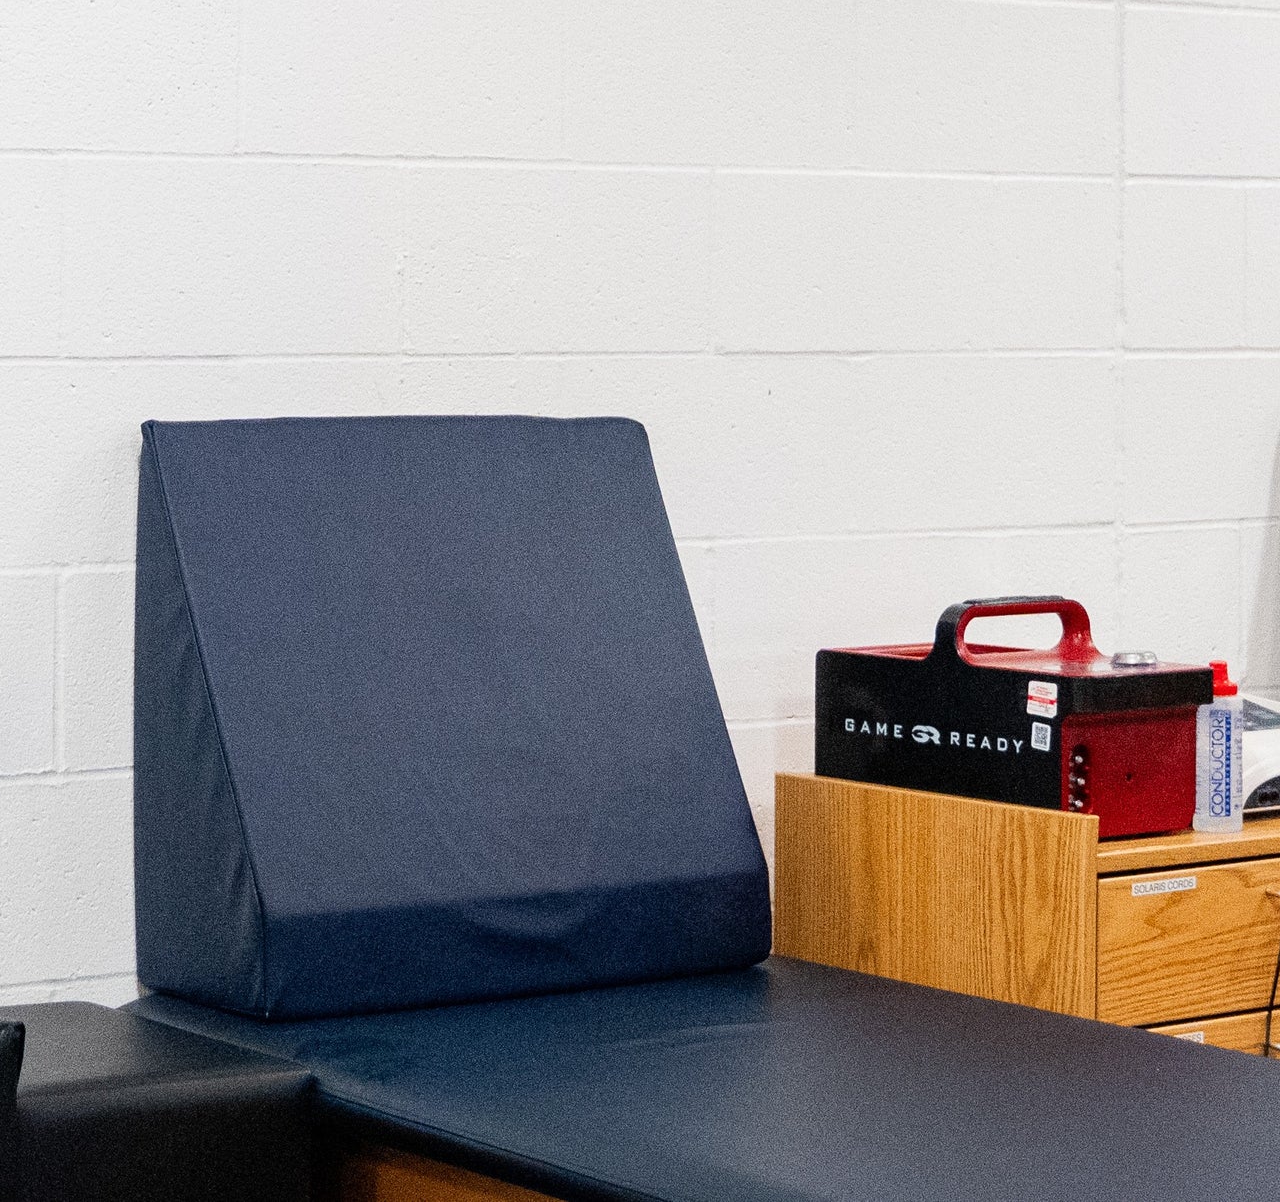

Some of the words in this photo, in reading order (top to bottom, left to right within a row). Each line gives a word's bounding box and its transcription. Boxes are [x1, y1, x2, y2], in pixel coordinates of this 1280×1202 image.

[845, 718, 903, 739] GAME
[950, 731, 1024, 753] READY
[1211, 718, 1224, 816] CONDUCTOR
[1134, 882, 1166, 895] SOLARIS
